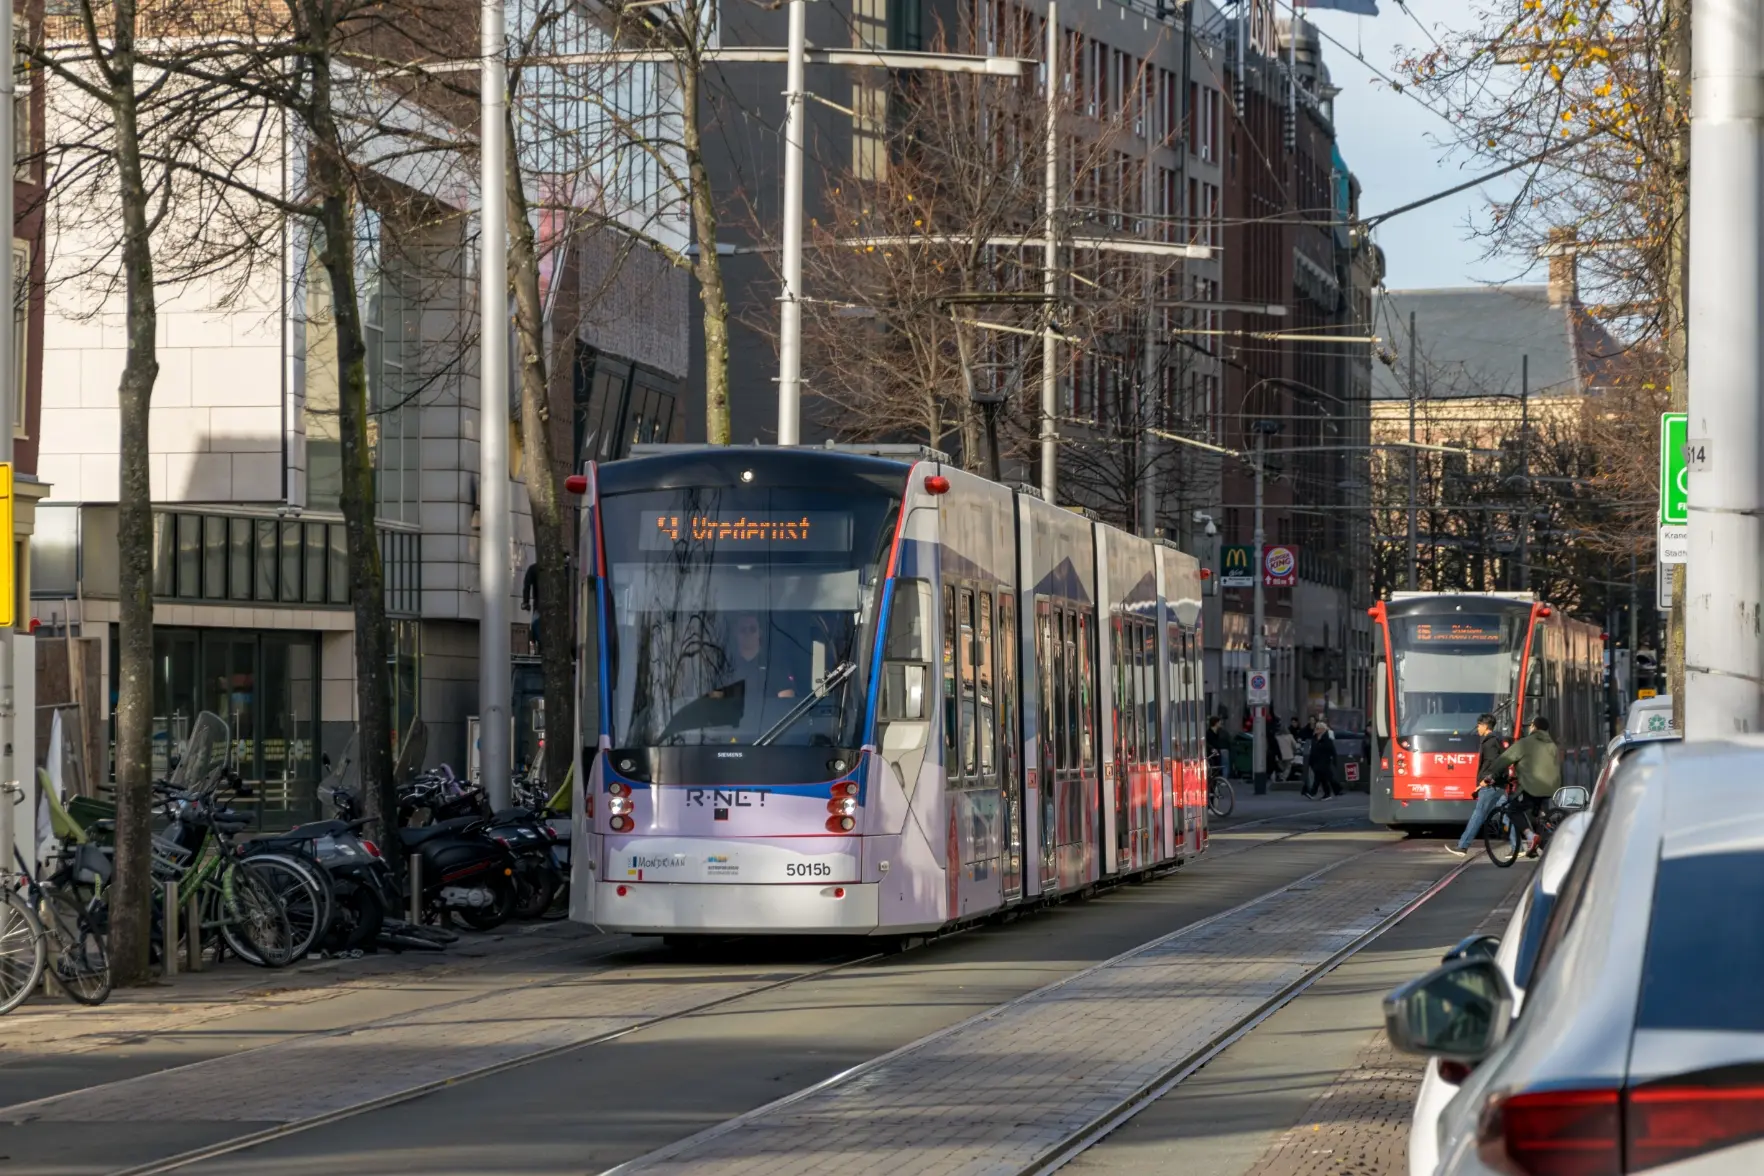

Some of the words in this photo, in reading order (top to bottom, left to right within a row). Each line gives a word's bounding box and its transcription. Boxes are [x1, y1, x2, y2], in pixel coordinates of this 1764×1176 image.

[1269, 553, 1290, 563] BURGER
[1270, 557, 1291, 569] KING
[786, 862, 831, 876] 5015b
